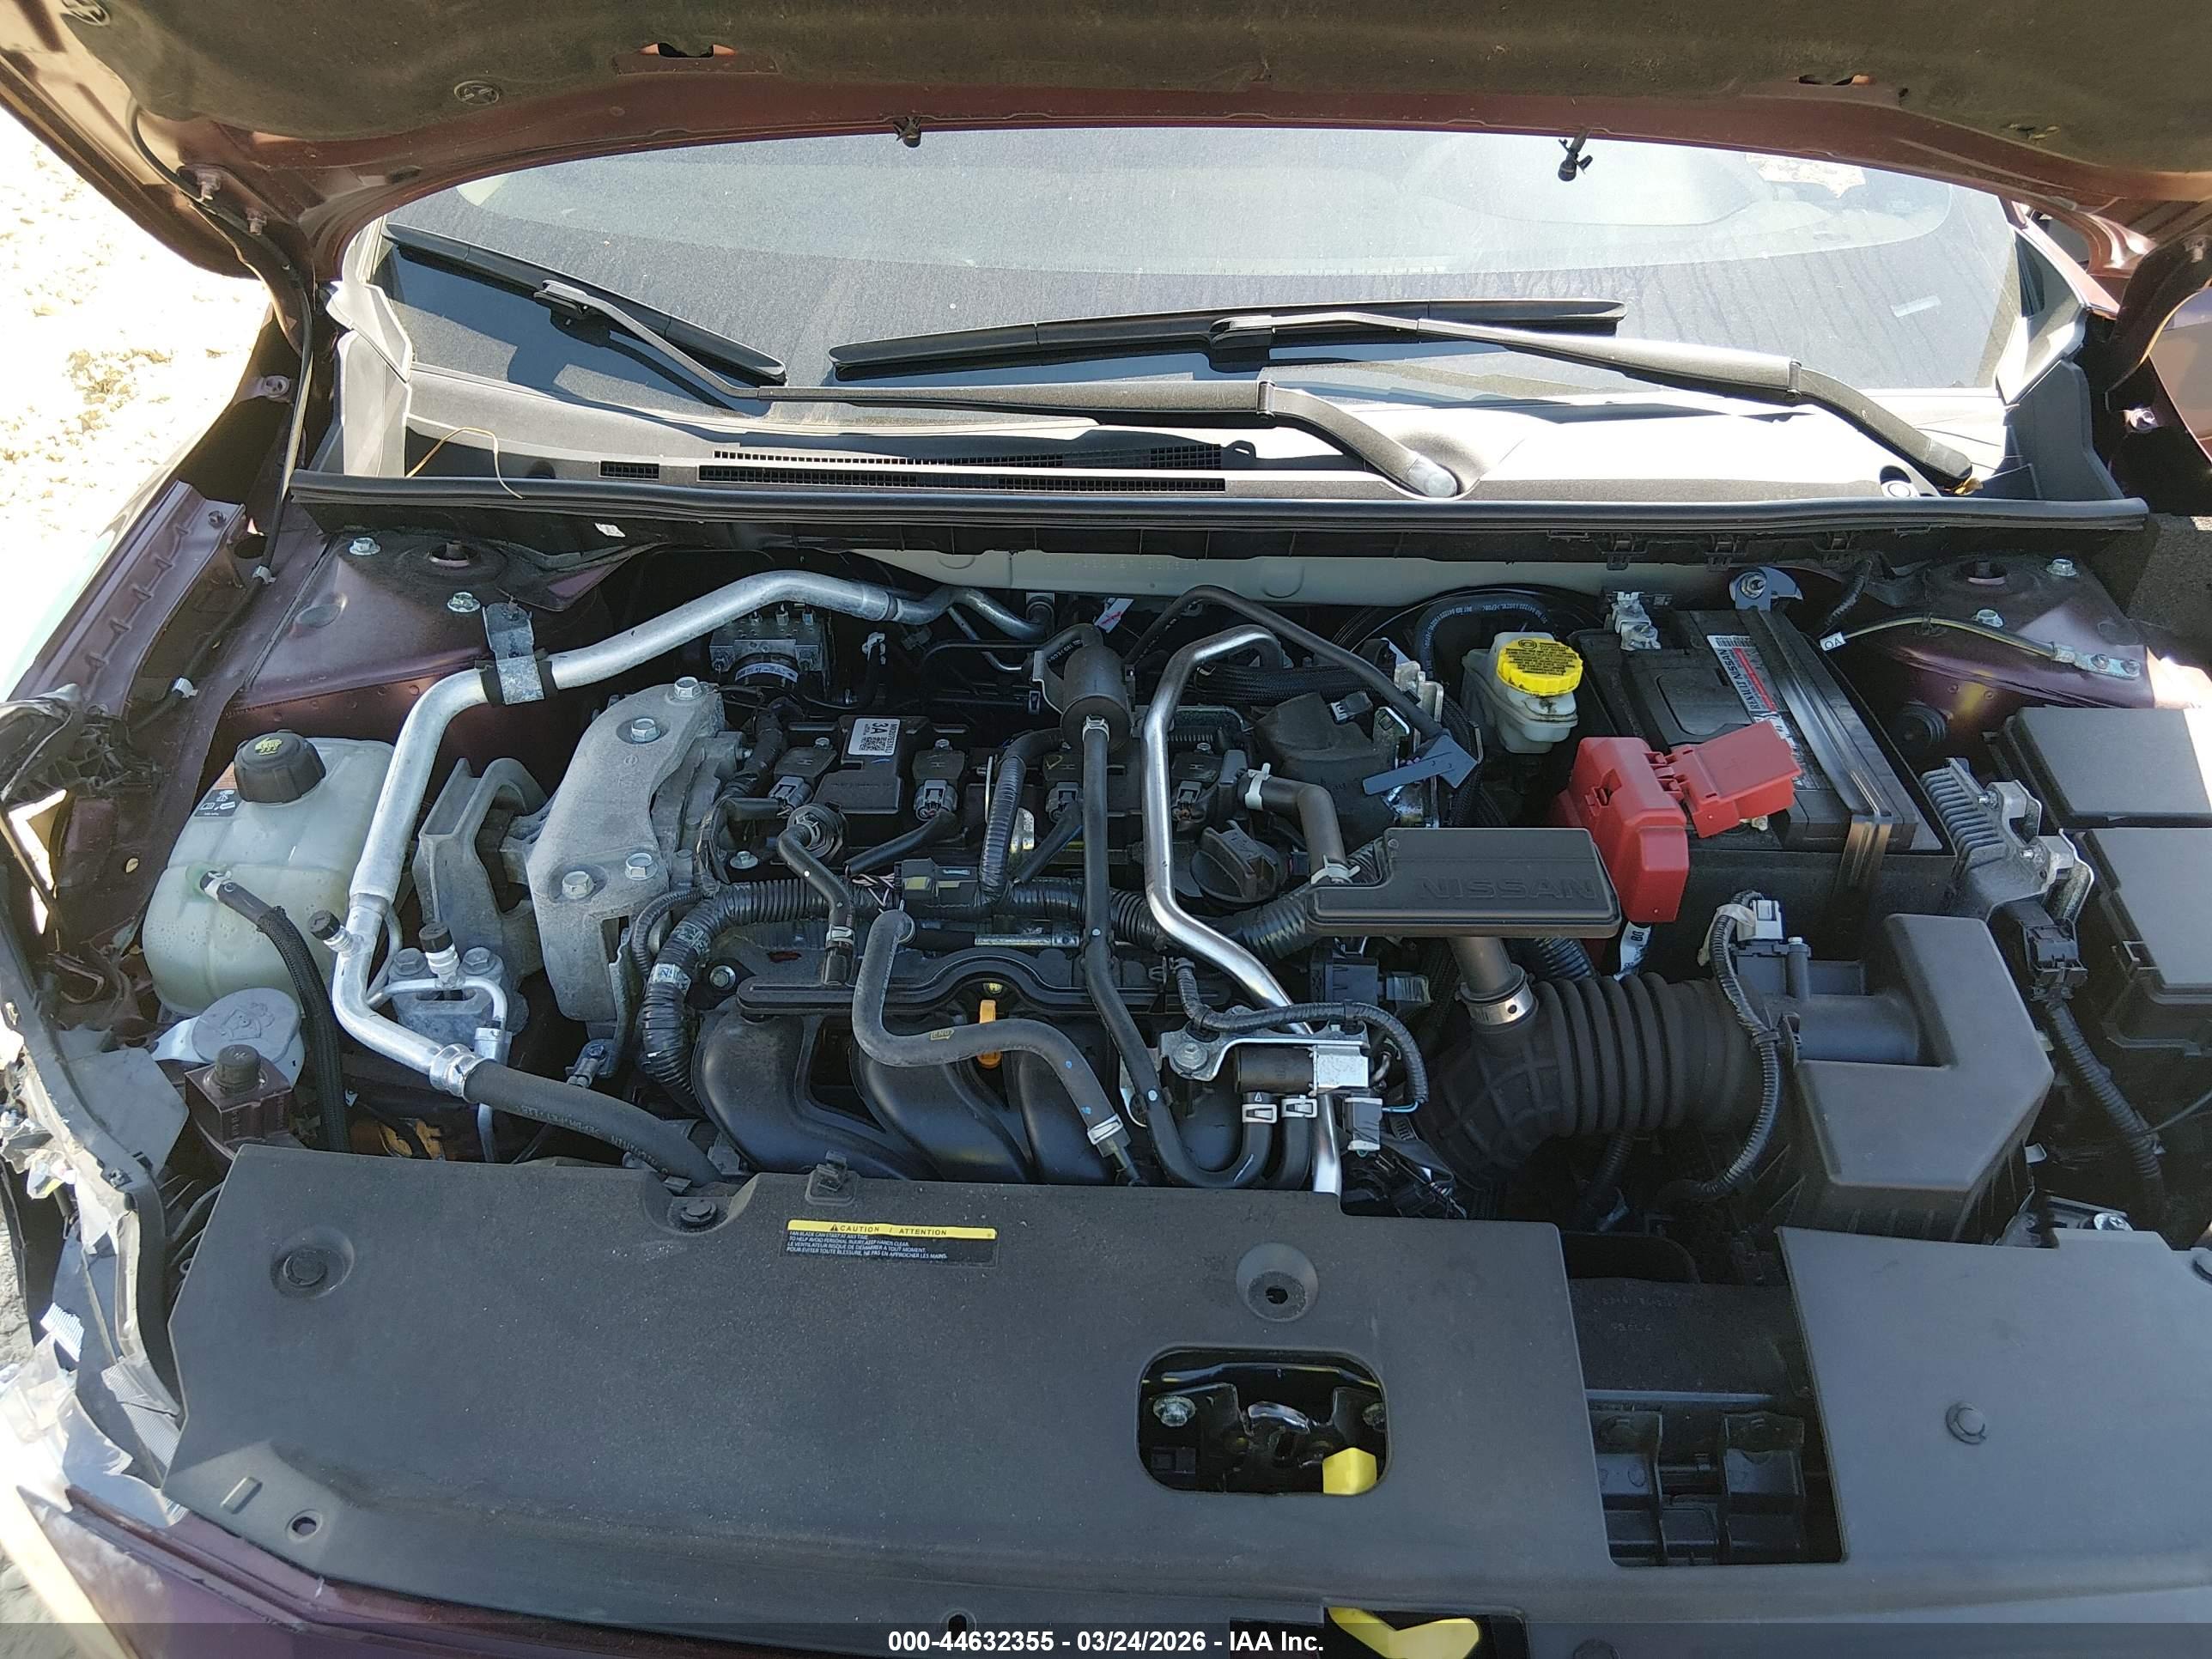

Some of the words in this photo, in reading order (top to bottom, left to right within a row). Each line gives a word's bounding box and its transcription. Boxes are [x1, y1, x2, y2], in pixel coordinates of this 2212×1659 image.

[1718, 648, 1743, 681] NISSAN
[871, 722, 889, 734] 3A
[1421, 877, 1598, 898] NISSAN
[840, 1224, 880, 1233] CAUTION
